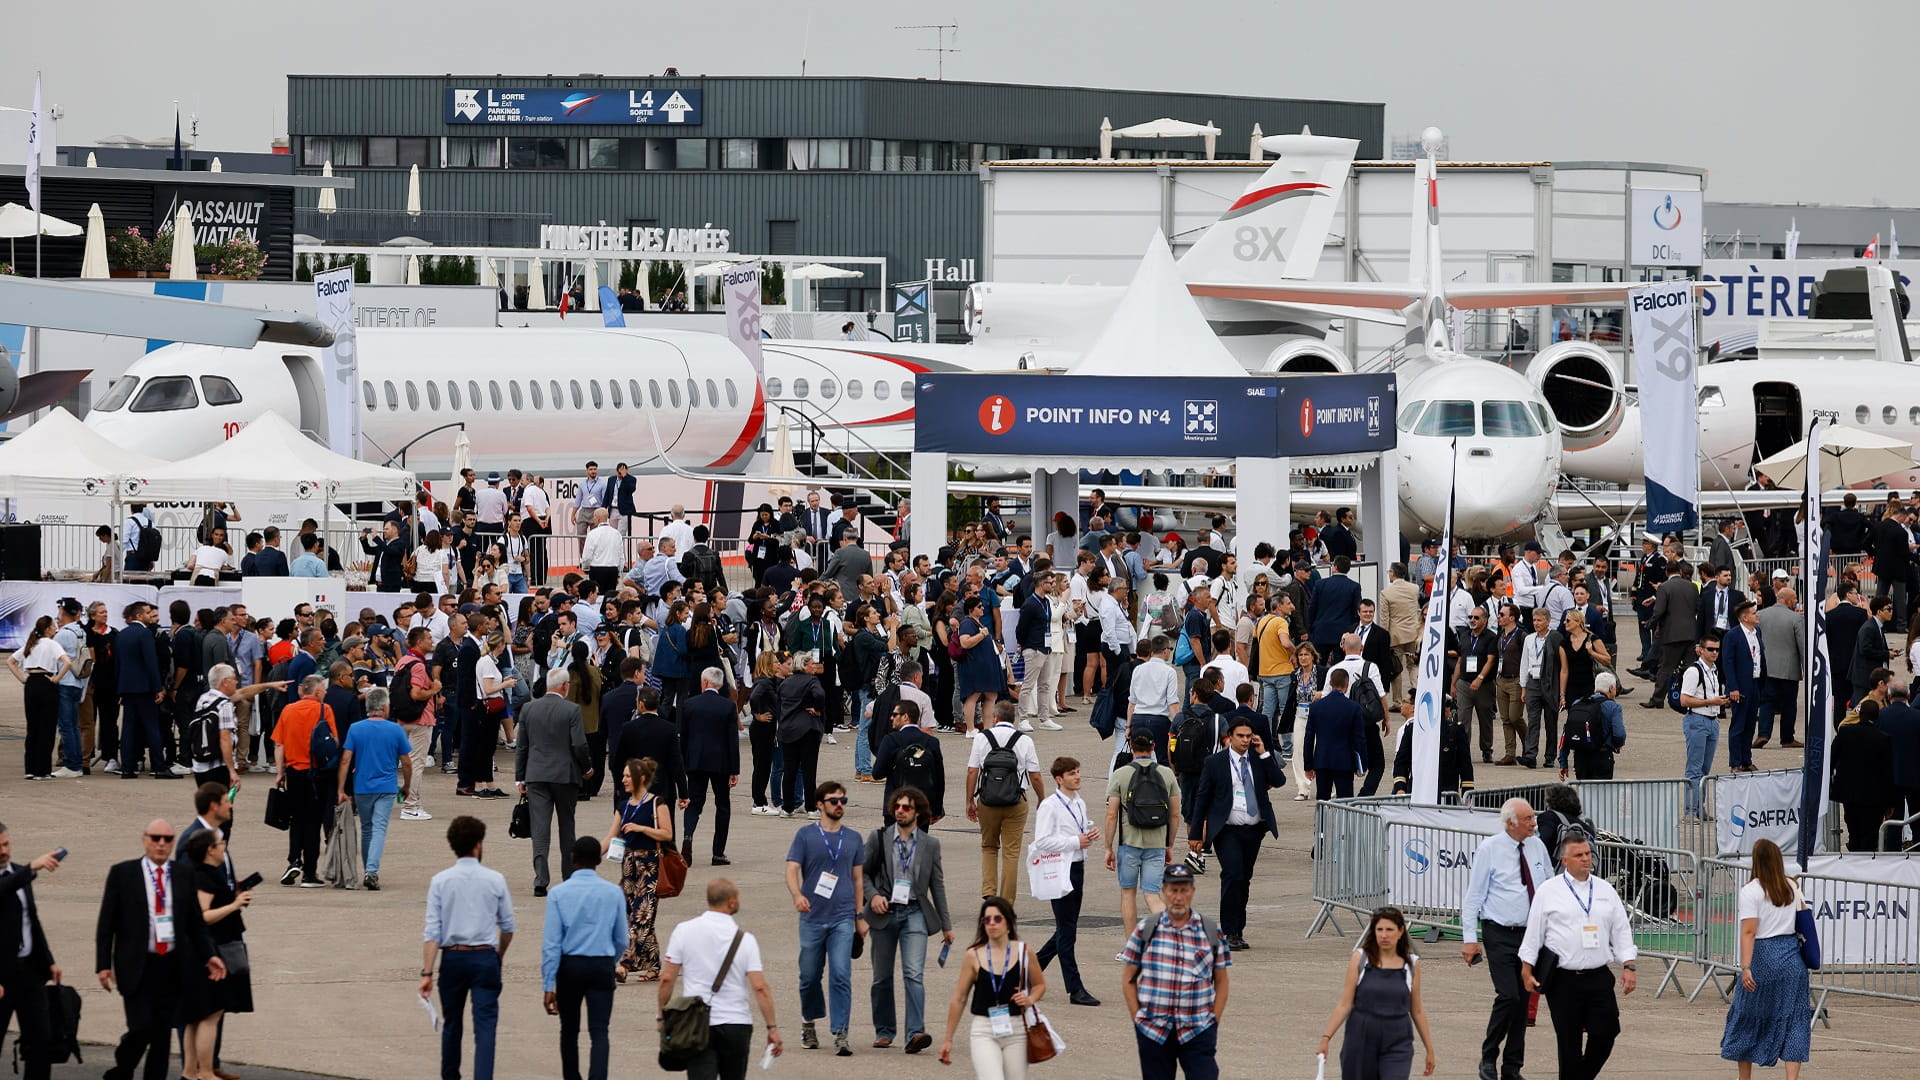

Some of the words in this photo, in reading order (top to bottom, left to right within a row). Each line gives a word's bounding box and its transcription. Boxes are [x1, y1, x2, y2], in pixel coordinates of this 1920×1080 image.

[487, 88, 500, 107] L
[630, 90, 654, 108] L4
[183, 200, 264, 224] DASSAULT
[192, 225, 258, 247] VIATION
[540, 220, 629, 250] MINISTÈRE
[632, 226, 664, 252] DES
[666, 222, 730, 253] ARMÉES
[1232, 226, 1287, 262] 8X
[1652, 244, 1670, 260] DCI
[723, 270, 756, 286] Falcon
[924, 258, 976, 282] Hall
[1634, 289, 1688, 312] Falcon
[1700, 265, 1816, 317] STÈRE
[354, 306, 410, 328] HITECT
[734, 284, 760, 341] 8X
[1650, 310, 1692, 382] 6X
[1247, 388, 1266, 396] SIAE
[1026, 407, 1084, 424] POINT
[1089, 408, 1132, 424] INFO
[1138, 409, 1171, 424] N°4
[1316, 408, 1336, 424] POINT
[1338, 408, 1352, 424] INFO
[1354, 408, 1364, 422] N°4
[1813, 409, 1840, 418] Falcon
[556, 480, 579, 500] Falc
[556, 502, 578, 535] 10
[157, 511, 203, 551] 0X
[1437, 849, 1476, 870] SA
